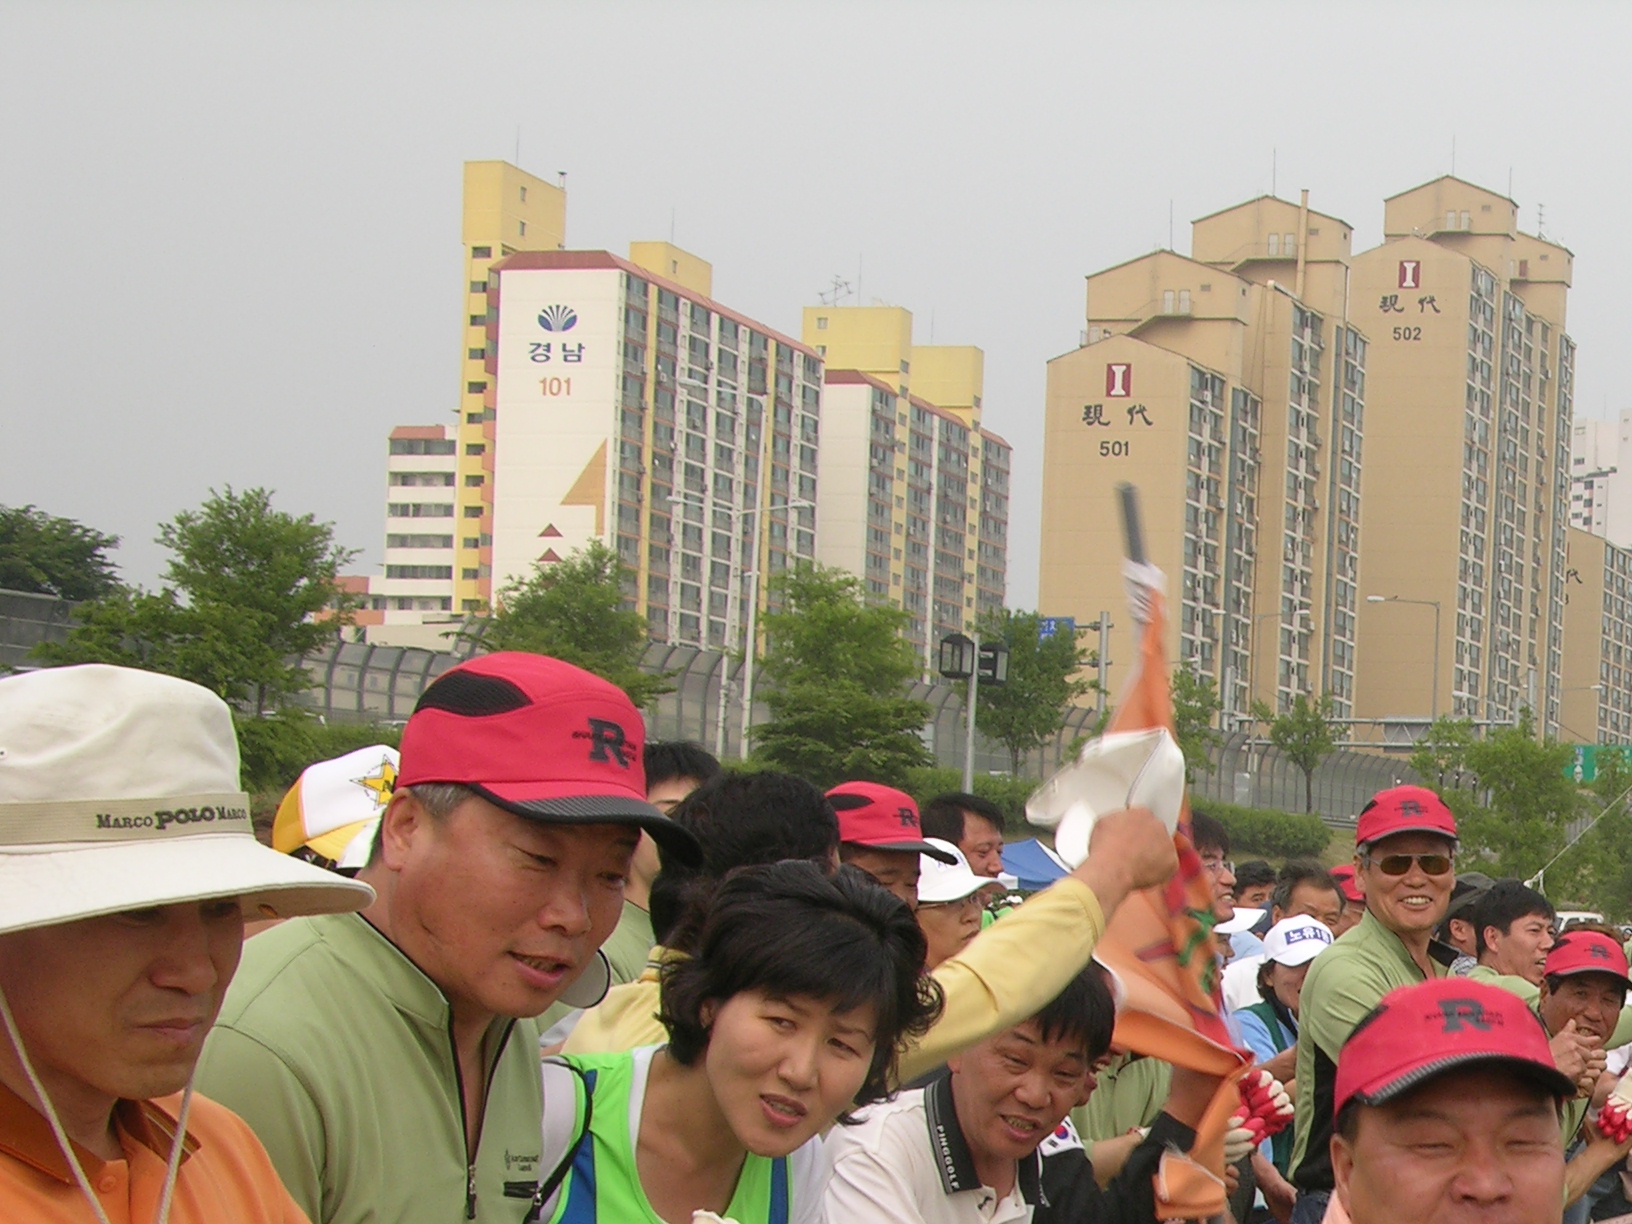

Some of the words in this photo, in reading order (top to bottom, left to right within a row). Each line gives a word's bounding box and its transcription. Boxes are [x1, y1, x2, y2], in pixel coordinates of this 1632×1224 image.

[1393, 326, 1422, 341] 502
[528, 342, 586, 363] 경남
[539, 377, 571, 396] 101
[1099, 440, 1129, 457] 501
[154, 806, 217, 830] POLO
